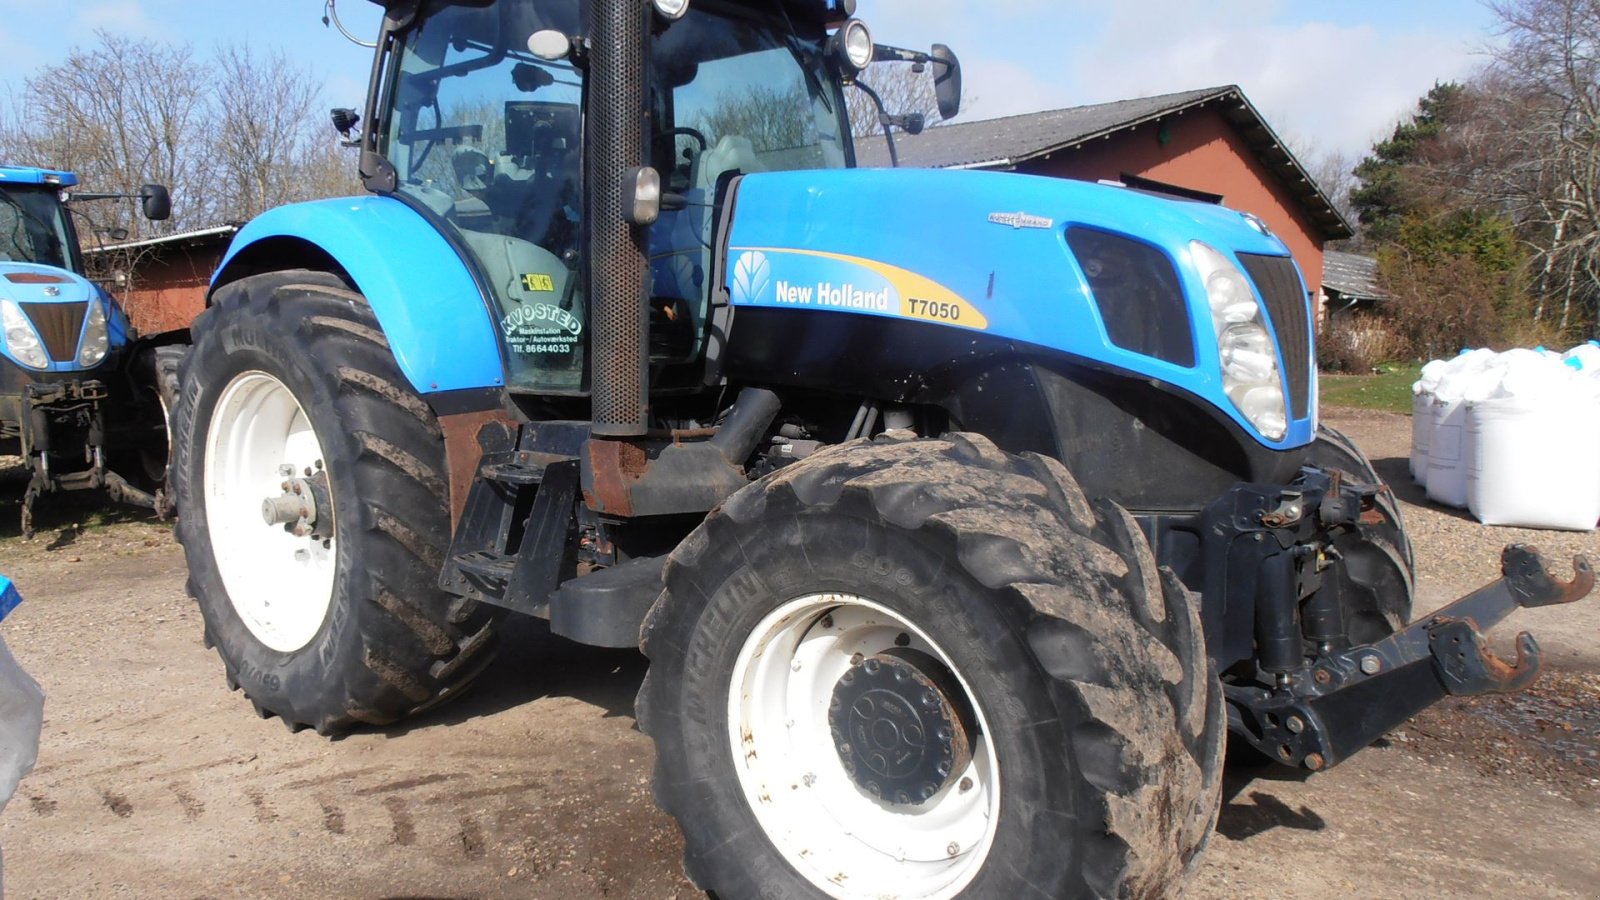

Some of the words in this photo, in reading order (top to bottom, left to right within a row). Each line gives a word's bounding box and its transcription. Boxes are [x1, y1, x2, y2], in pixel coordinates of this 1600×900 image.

[775, 280, 813, 304] New
[817, 281, 888, 311] Holland
[908, 298, 960, 321] T7050
[500, 303, 582, 336] KVOSTED
[513, 345, 525, 353] Tlf.
[685, 570, 759, 725] MICHELIN
